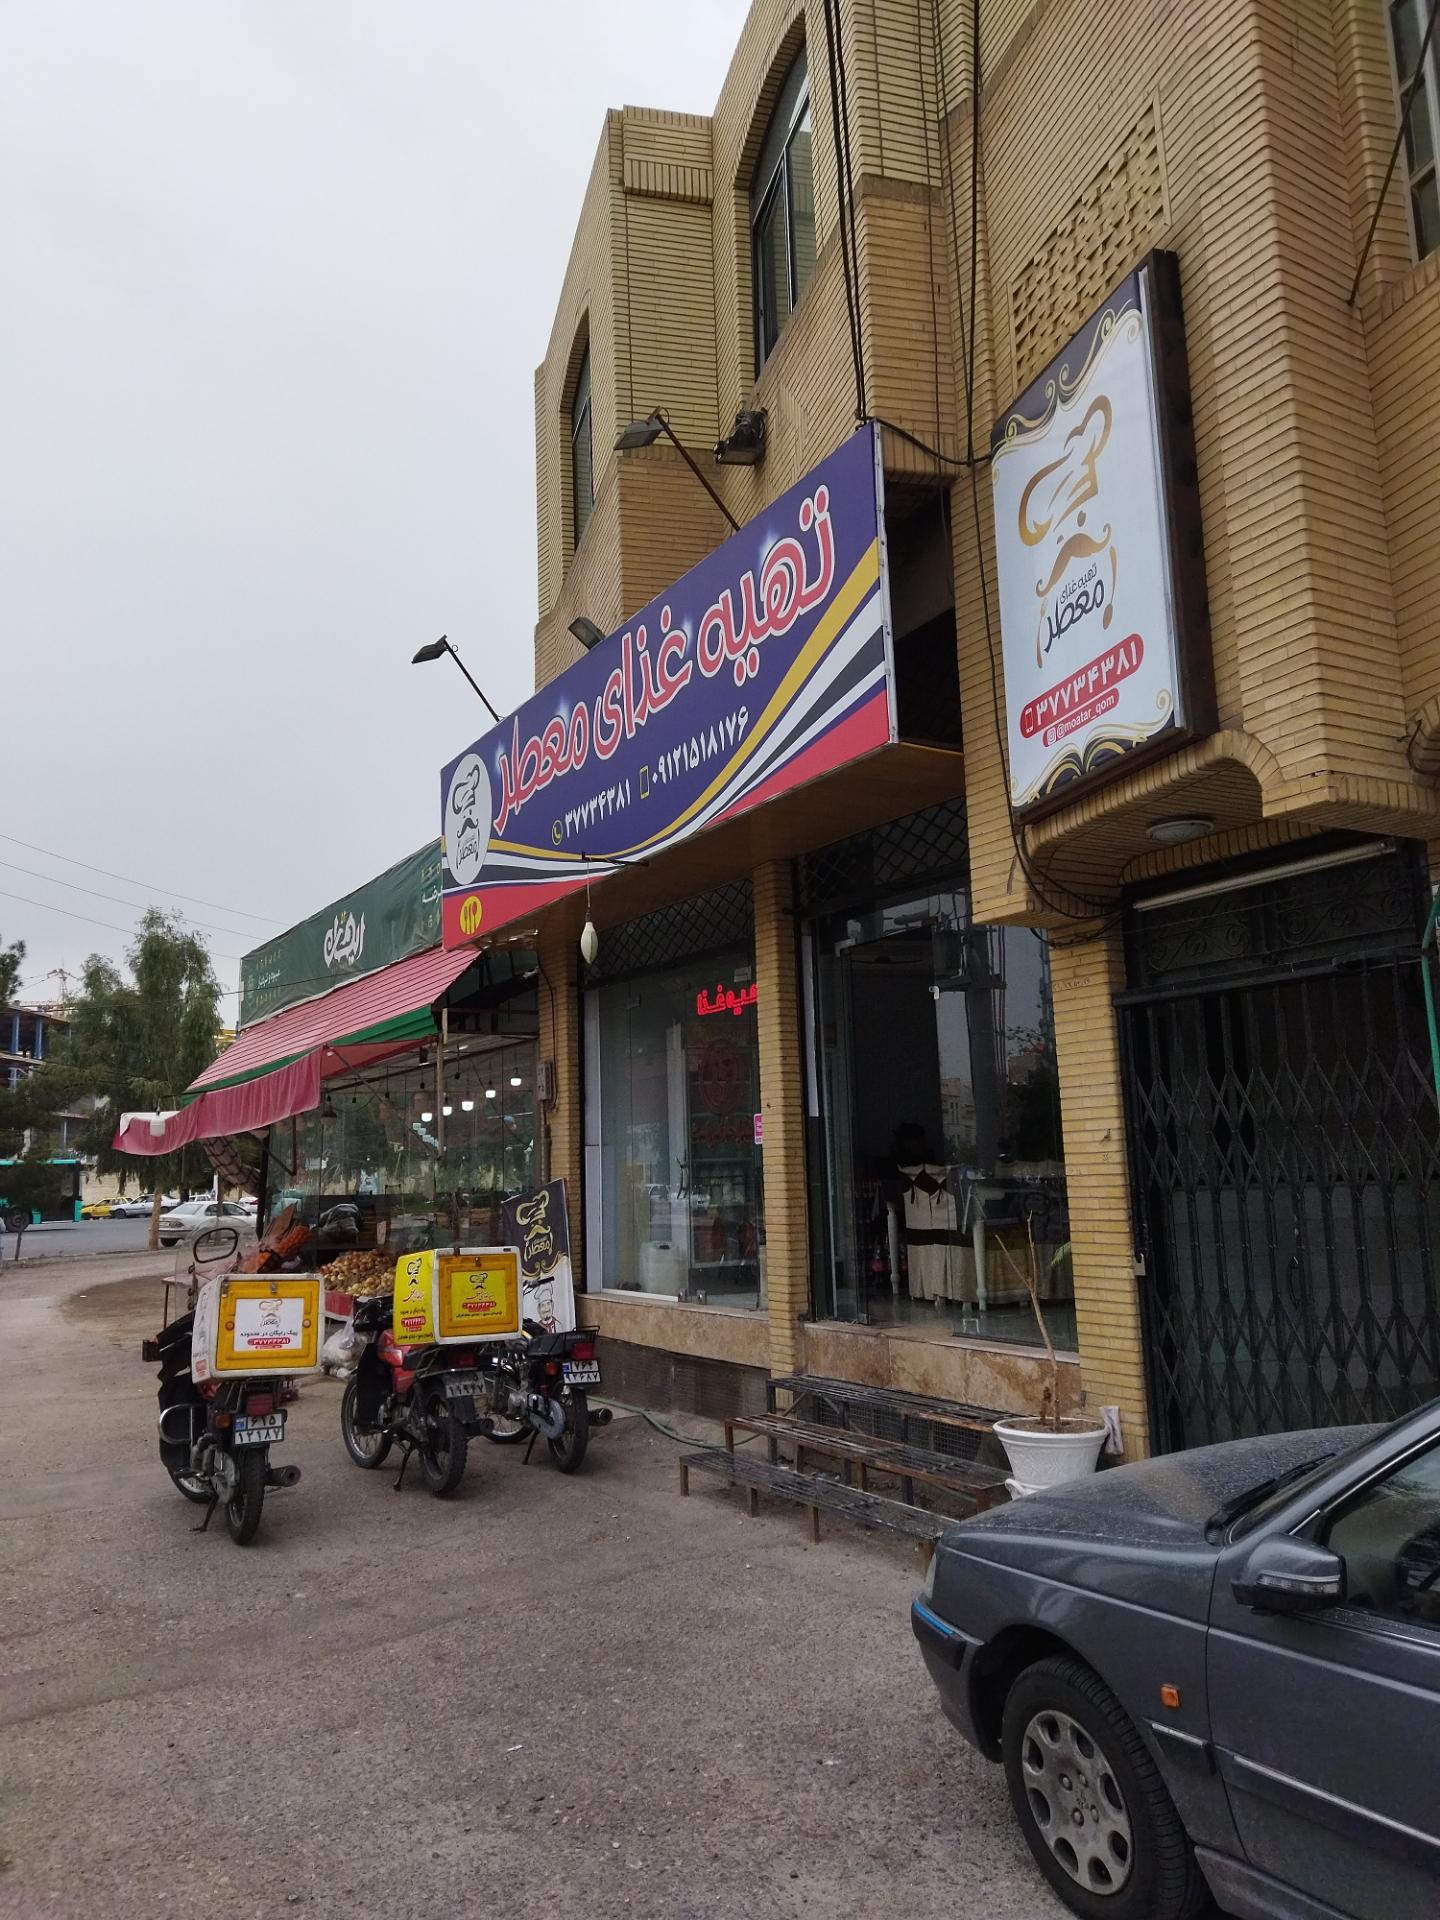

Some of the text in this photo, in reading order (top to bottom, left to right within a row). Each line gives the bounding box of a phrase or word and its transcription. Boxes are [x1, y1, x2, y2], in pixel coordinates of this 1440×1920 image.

[1044, 579, 1105, 653] معطر
[493, 485, 835, 837] تهیه غذای معطر
[1036, 641, 1138, 725] ۳۷۷۳۴۳۸۱
[1057, 694, 1115, 738] @moatar_qom
[564, 705, 750, 839] ۳۷۷۳۴۳۸۱ ۰۹۱۲۱۵۱۸۱۷۶
